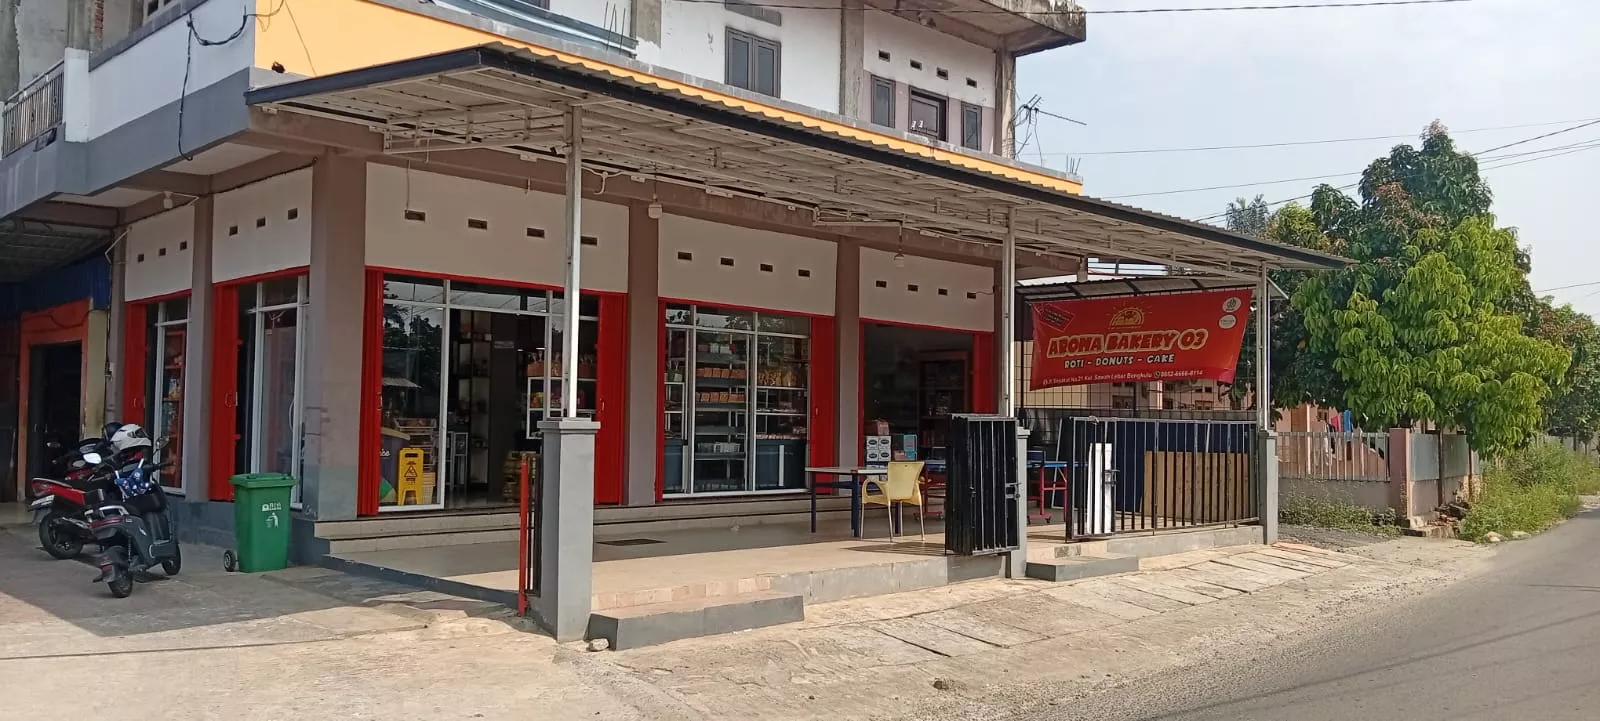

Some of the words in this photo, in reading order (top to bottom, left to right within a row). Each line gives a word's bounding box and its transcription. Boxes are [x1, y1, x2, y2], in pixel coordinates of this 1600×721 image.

[1048, 334, 1103, 357] AROMA
[1103, 329, 1179, 352] BAKERY
[1178, 329, 1208, 350] 03
[1064, 359, 1084, 369] ROTI
[1095, 356, 1134, 366] DONUTS
[1146, 354, 1175, 364] CAKE
[1126, 372, 1152, 380] Bengkulu
